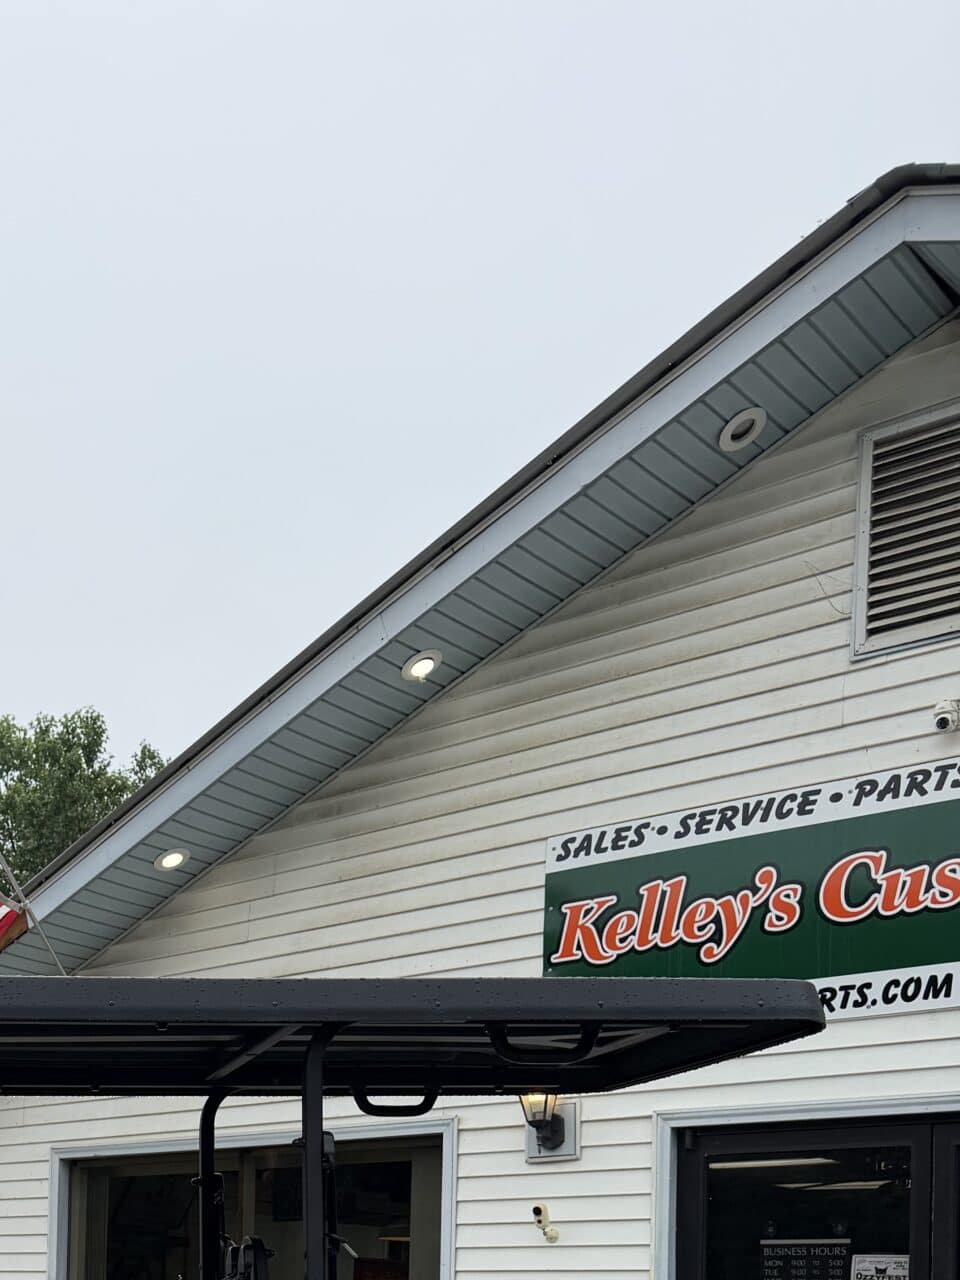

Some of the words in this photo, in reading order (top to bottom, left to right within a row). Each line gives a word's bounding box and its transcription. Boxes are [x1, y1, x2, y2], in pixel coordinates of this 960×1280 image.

[555, 822, 651, 862] SALES
[673, 788, 822, 840] SERVICE
[550, 866, 803, 965] Kelley's
[763, 1247, 807, 1256] BUSINESS
[810, 1246, 847, 1256] HOURS
